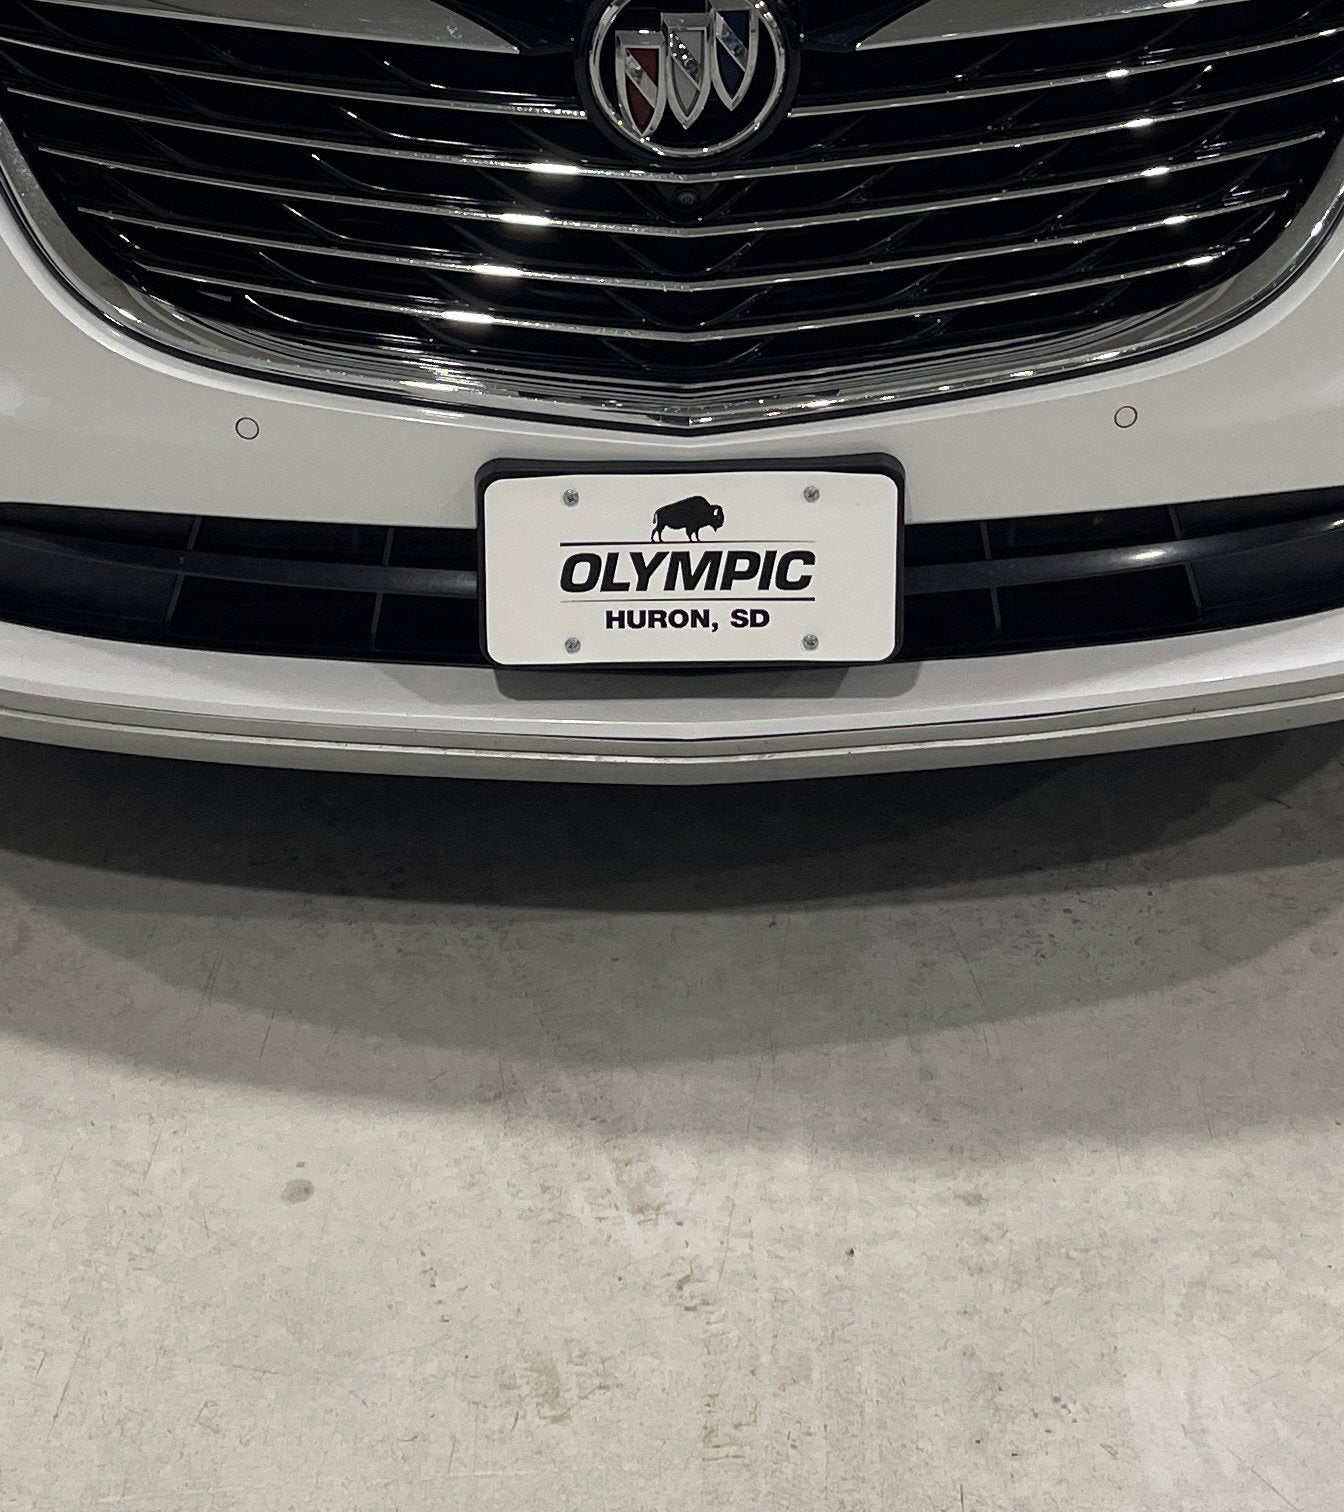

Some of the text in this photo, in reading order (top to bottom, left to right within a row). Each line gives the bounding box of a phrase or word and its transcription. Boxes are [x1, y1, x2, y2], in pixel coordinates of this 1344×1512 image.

[560, 550, 816, 593] OLYMPIC
[606, 608, 770, 633] HURON, SD
